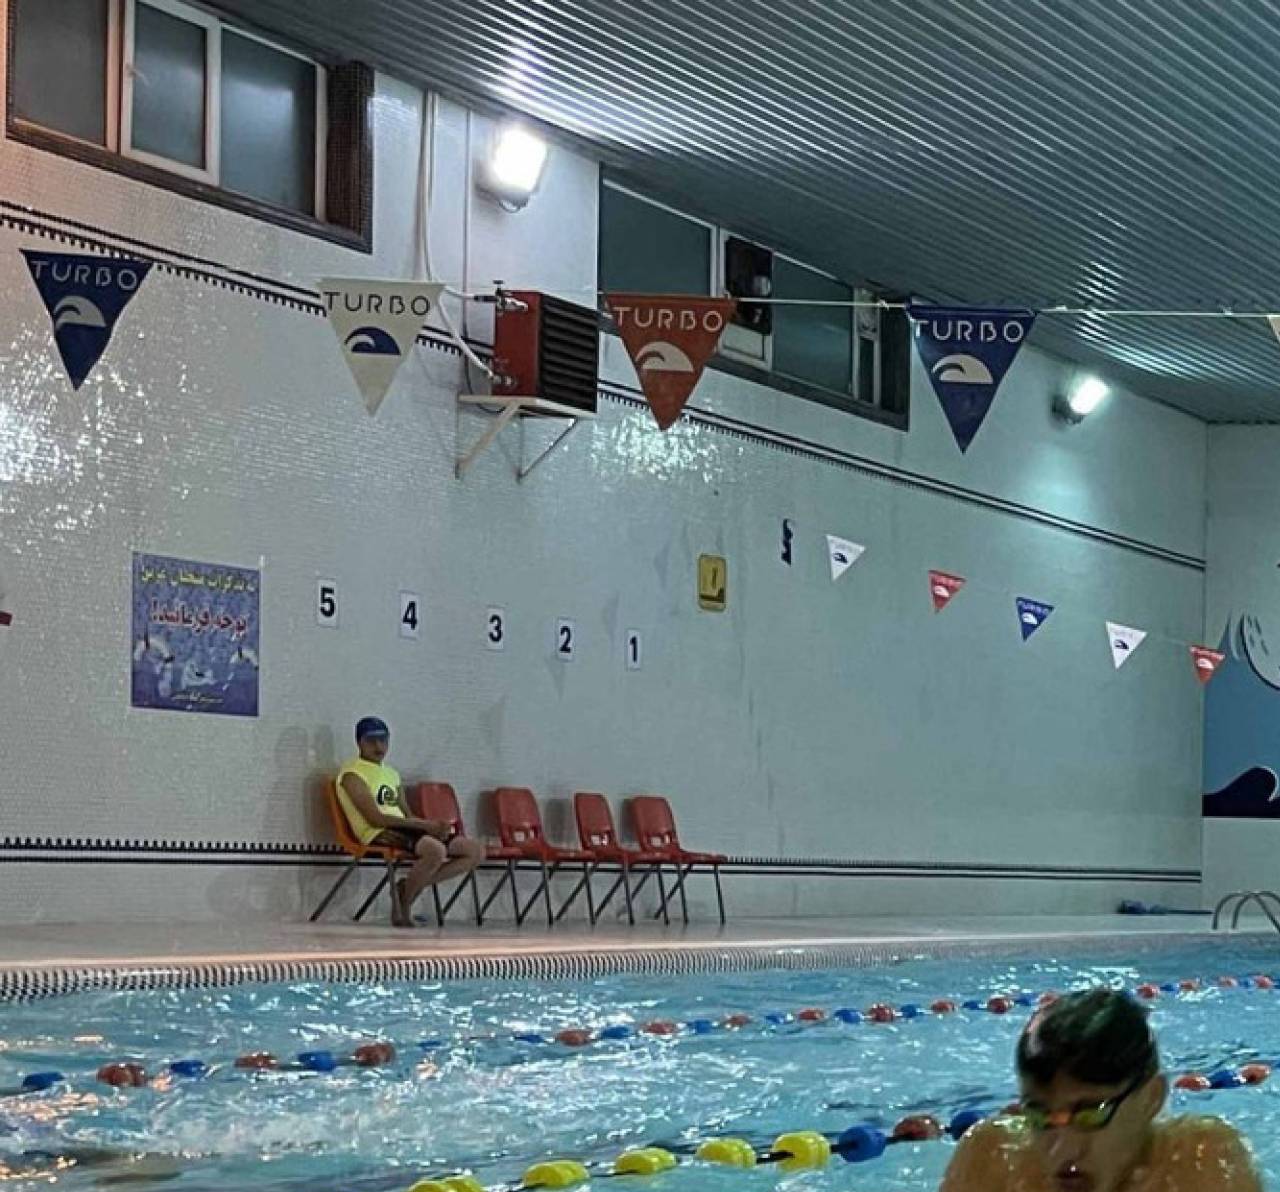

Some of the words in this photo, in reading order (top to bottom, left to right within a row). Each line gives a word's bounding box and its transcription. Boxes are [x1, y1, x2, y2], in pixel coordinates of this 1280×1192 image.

[32, 260, 137, 291] TURBO
[323, 291, 430, 315] TURBO
[614, 307, 723, 332] TURBO
[915, 319, 1023, 343] TURBO
[320, 587, 335, 617] 5
[402, 601, 417, 629] 4
[489, 614, 502, 642] 3
[560, 626, 571, 653] 2
[629, 636, 638, 662] 1
